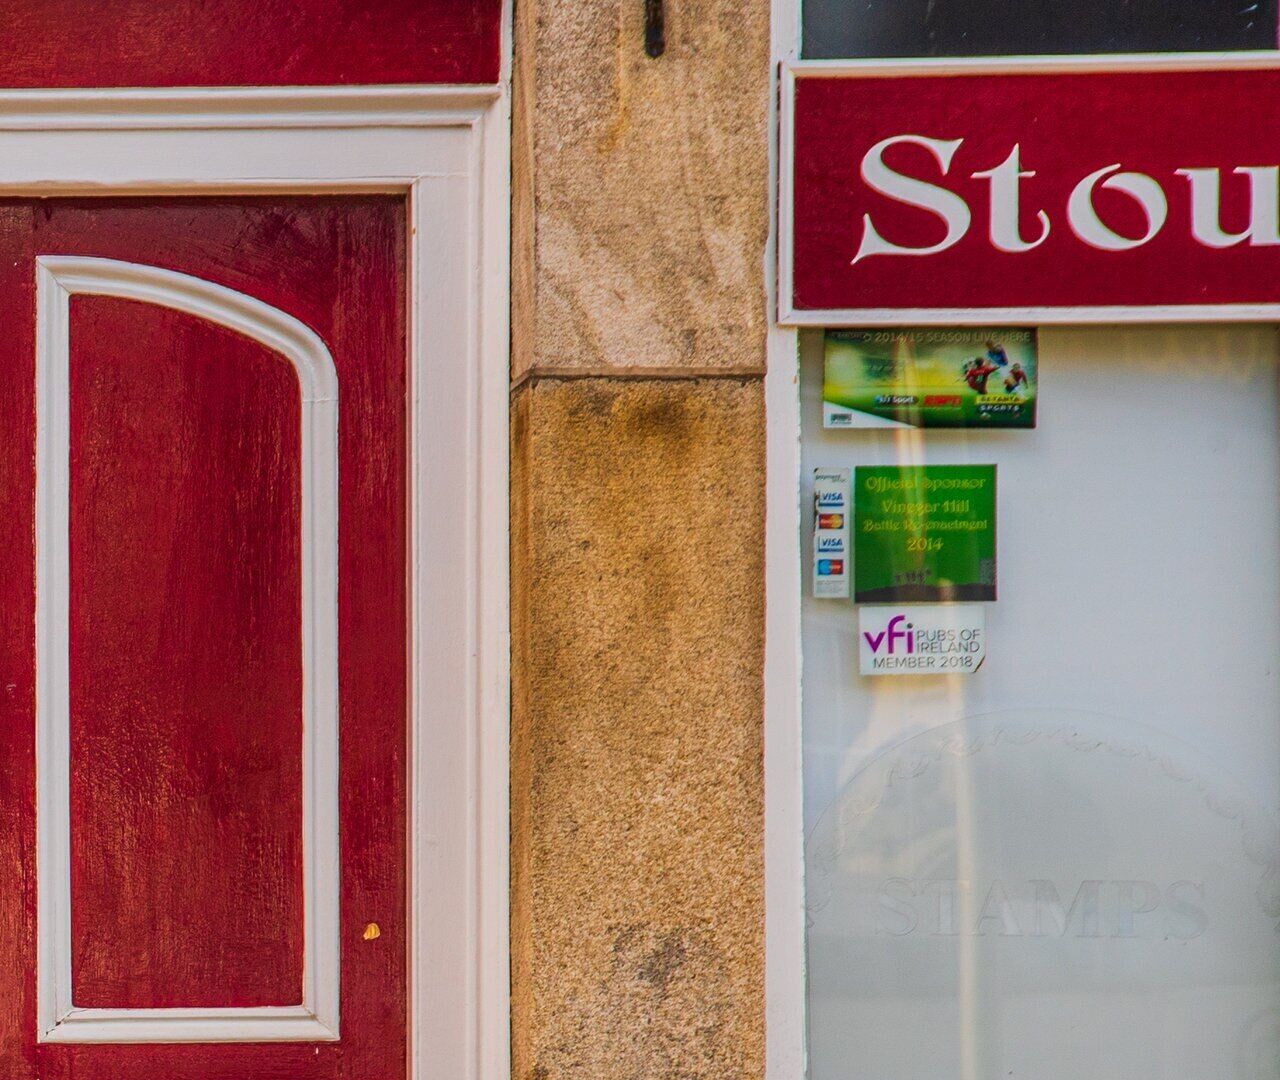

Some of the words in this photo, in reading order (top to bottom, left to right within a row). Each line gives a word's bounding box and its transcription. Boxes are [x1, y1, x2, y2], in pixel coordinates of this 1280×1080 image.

[926, 332, 971, 343] SEASON
[973, 332, 999, 342] LIVE
[1000, 331, 1031, 342] HERE
[822, 493, 843, 501] VISA
[822, 538, 843, 547] VISA
[907, 538, 944, 551] 2014
[864, 615, 914, 654] vfi
[917, 629, 955, 641] PUBS
[960, 629, 981, 640] OF
[917, 641, 980, 653] IRELAND
[873, 657, 935, 668] MEMBER
[941, 656, 973, 667] 2018
[875, 877, 1210, 938] STAMPS
